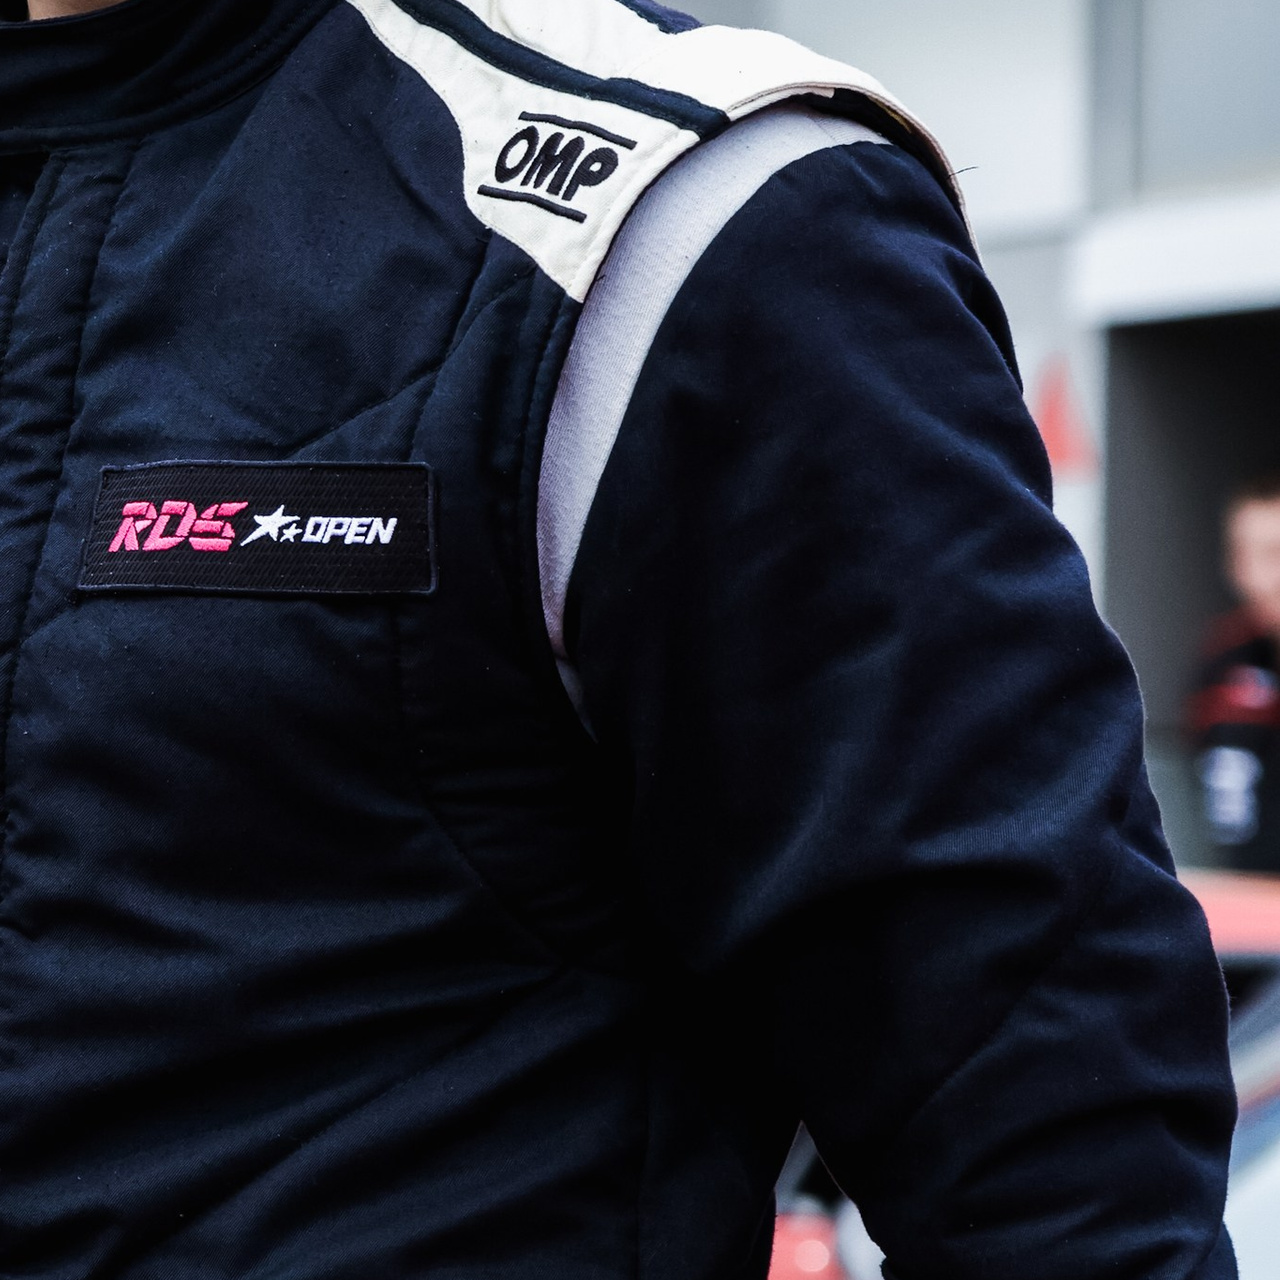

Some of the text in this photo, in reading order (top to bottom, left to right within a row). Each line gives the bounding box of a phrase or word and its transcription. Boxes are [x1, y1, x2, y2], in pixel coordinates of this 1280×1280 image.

[494, 124, 619, 202] OMP
[108, 500, 398, 553] RDS OPEN
